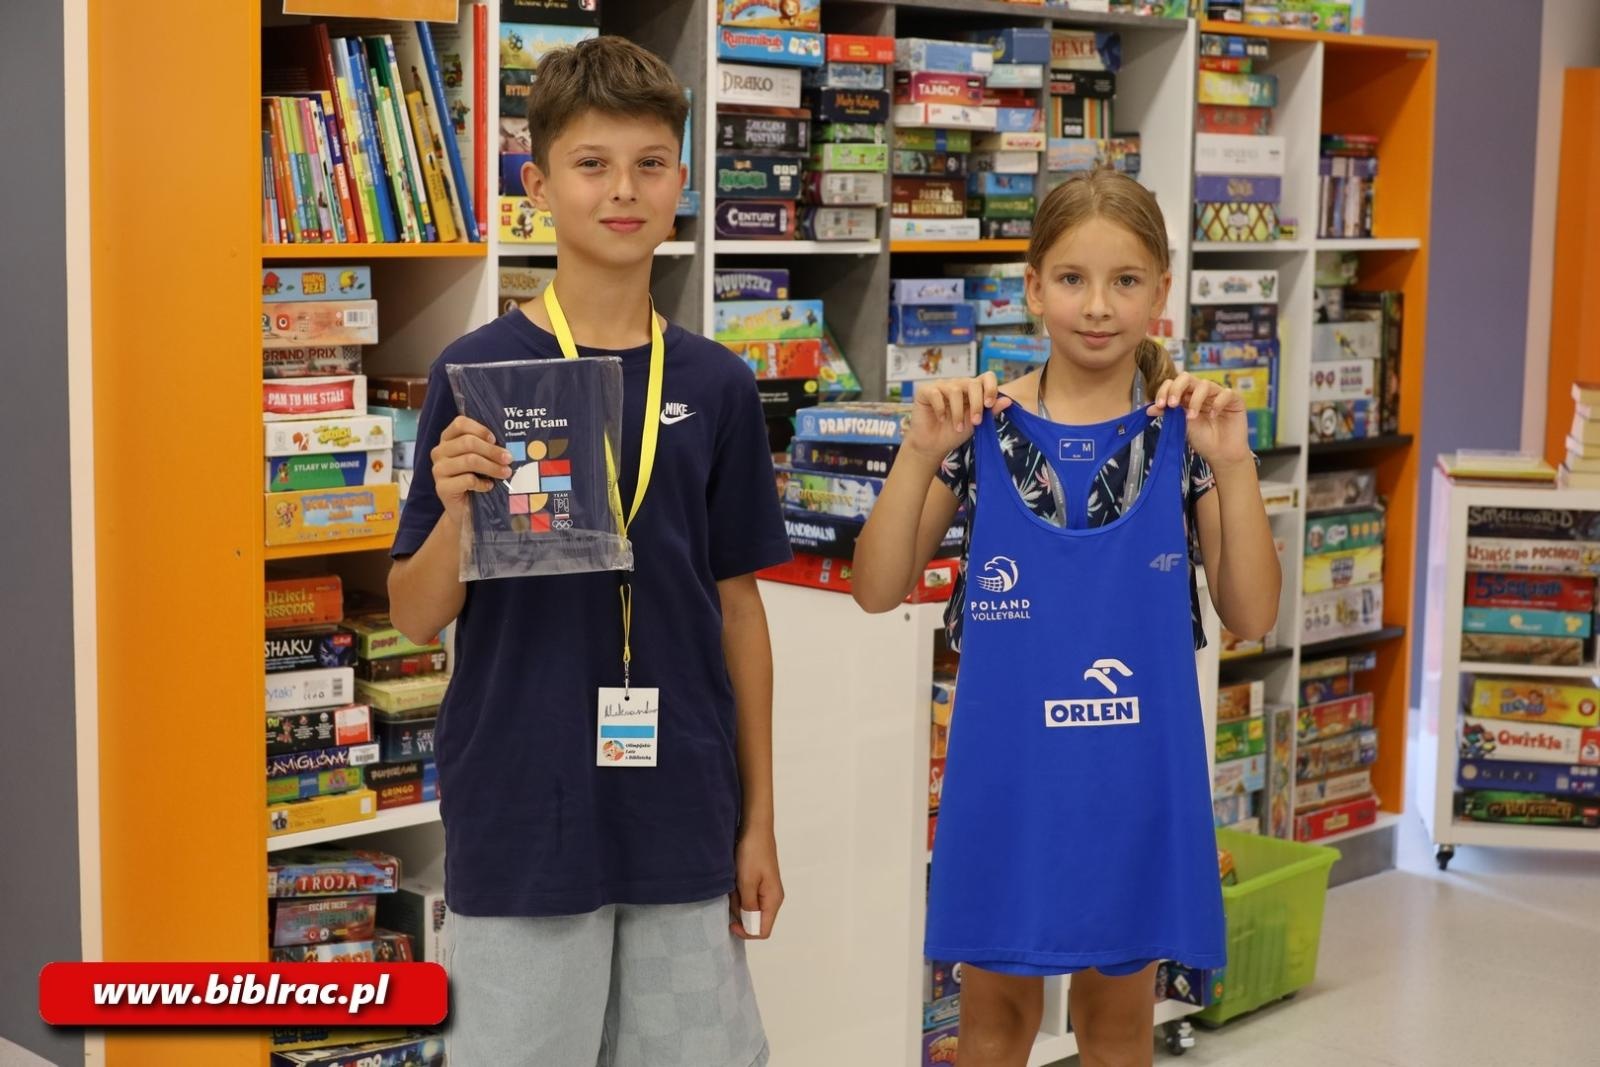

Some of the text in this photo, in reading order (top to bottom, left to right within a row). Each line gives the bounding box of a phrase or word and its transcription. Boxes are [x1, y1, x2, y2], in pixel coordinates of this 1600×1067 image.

[727, 207, 777, 226] CENTURY
[263, 347, 337, 361] GRAND PRIX
[288, 393, 302, 406] TU
[503, 407, 547, 418] We are
[665, 402, 689, 416] NIKE
[504, 417, 568, 431] One Team
[818, 417, 897, 438] DRAFTOZAUR
[1082, 443, 1092, 452] M
[1148, 553, 1184, 572] 4F
[970, 599, 1031, 612] POLAND
[971, 610, 1031, 621] VOLLEYBALL
[1050, 701, 1134, 724] ORLEN
[1497, 728, 1563, 752] Qwirkle
[300, 873, 358, 891] TROJA
